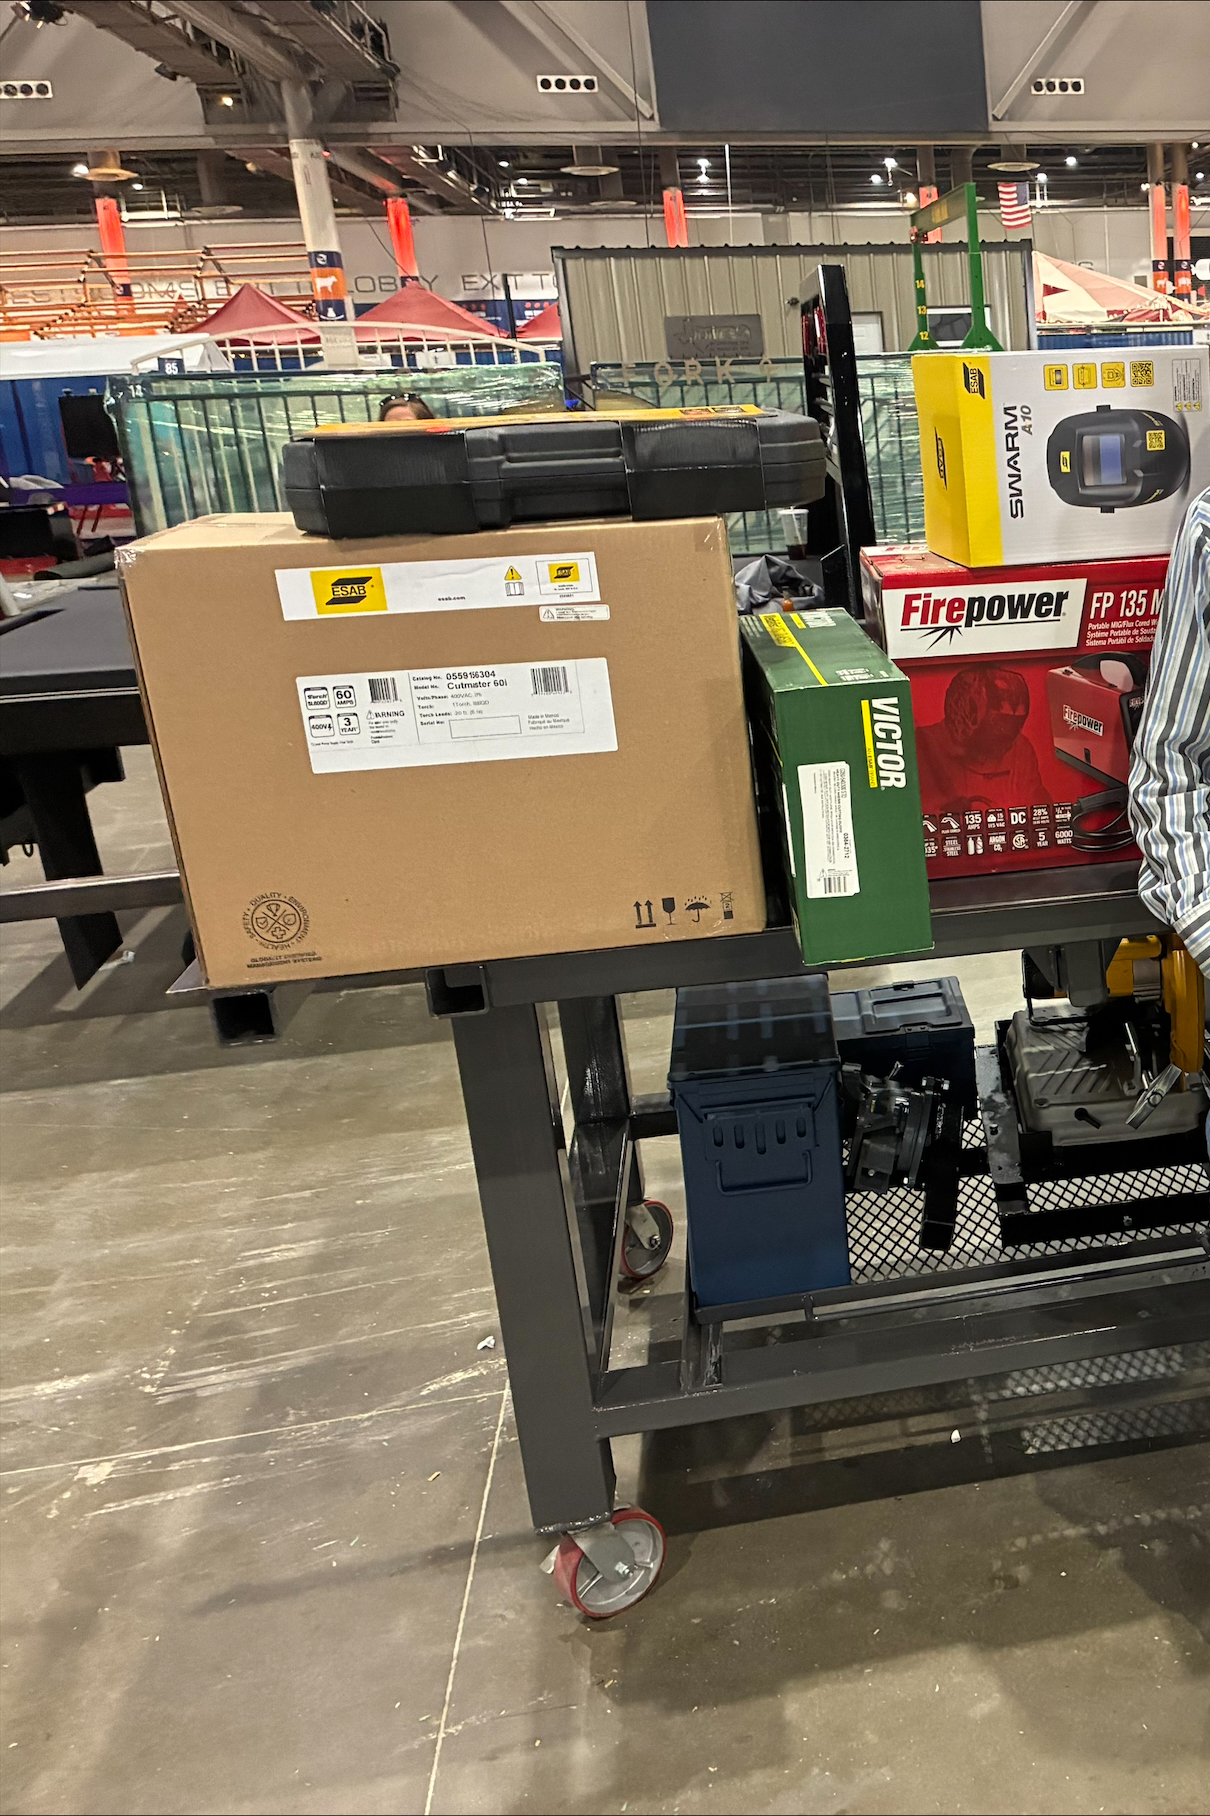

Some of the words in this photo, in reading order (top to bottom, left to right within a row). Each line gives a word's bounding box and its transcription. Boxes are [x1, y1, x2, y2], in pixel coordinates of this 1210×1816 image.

[916, 280, 925, 288] 14
[918, 306, 928, 315] 13
[920, 332, 929, 340] 12
[165, 362, 178, 374] 85
[970, 368, 978, 394] ESAB
[1003, 404, 1024, 519] SWARM
[1021, 404, 1033, 436] A10
[331, 585, 366, 597] ESAB
[901, 590, 1069, 628] Firepower
[1090, 592, 1114, 620] FP
[1120, 590, 1148, 617] 135
[1088, 622, 1109, 630] Portable
[1110, 628, 1131, 637] Portable
[447, 681, 491, 690] Cutmaster
[336, 690, 352, 699] 60
[344, 718, 351, 727] 3
[1063, 704, 1102, 733] Firepower
[872, 697, 906, 789] VICTOR
[1033, 808, 1048, 816] 28%
[965, 814, 982, 824] 135
[1010, 812, 1026, 825] DC
[1038, 832, 1046, 841] 5
[1055, 830, 1073, 838] 6000
[250, 892, 282, 906] QUALITY
